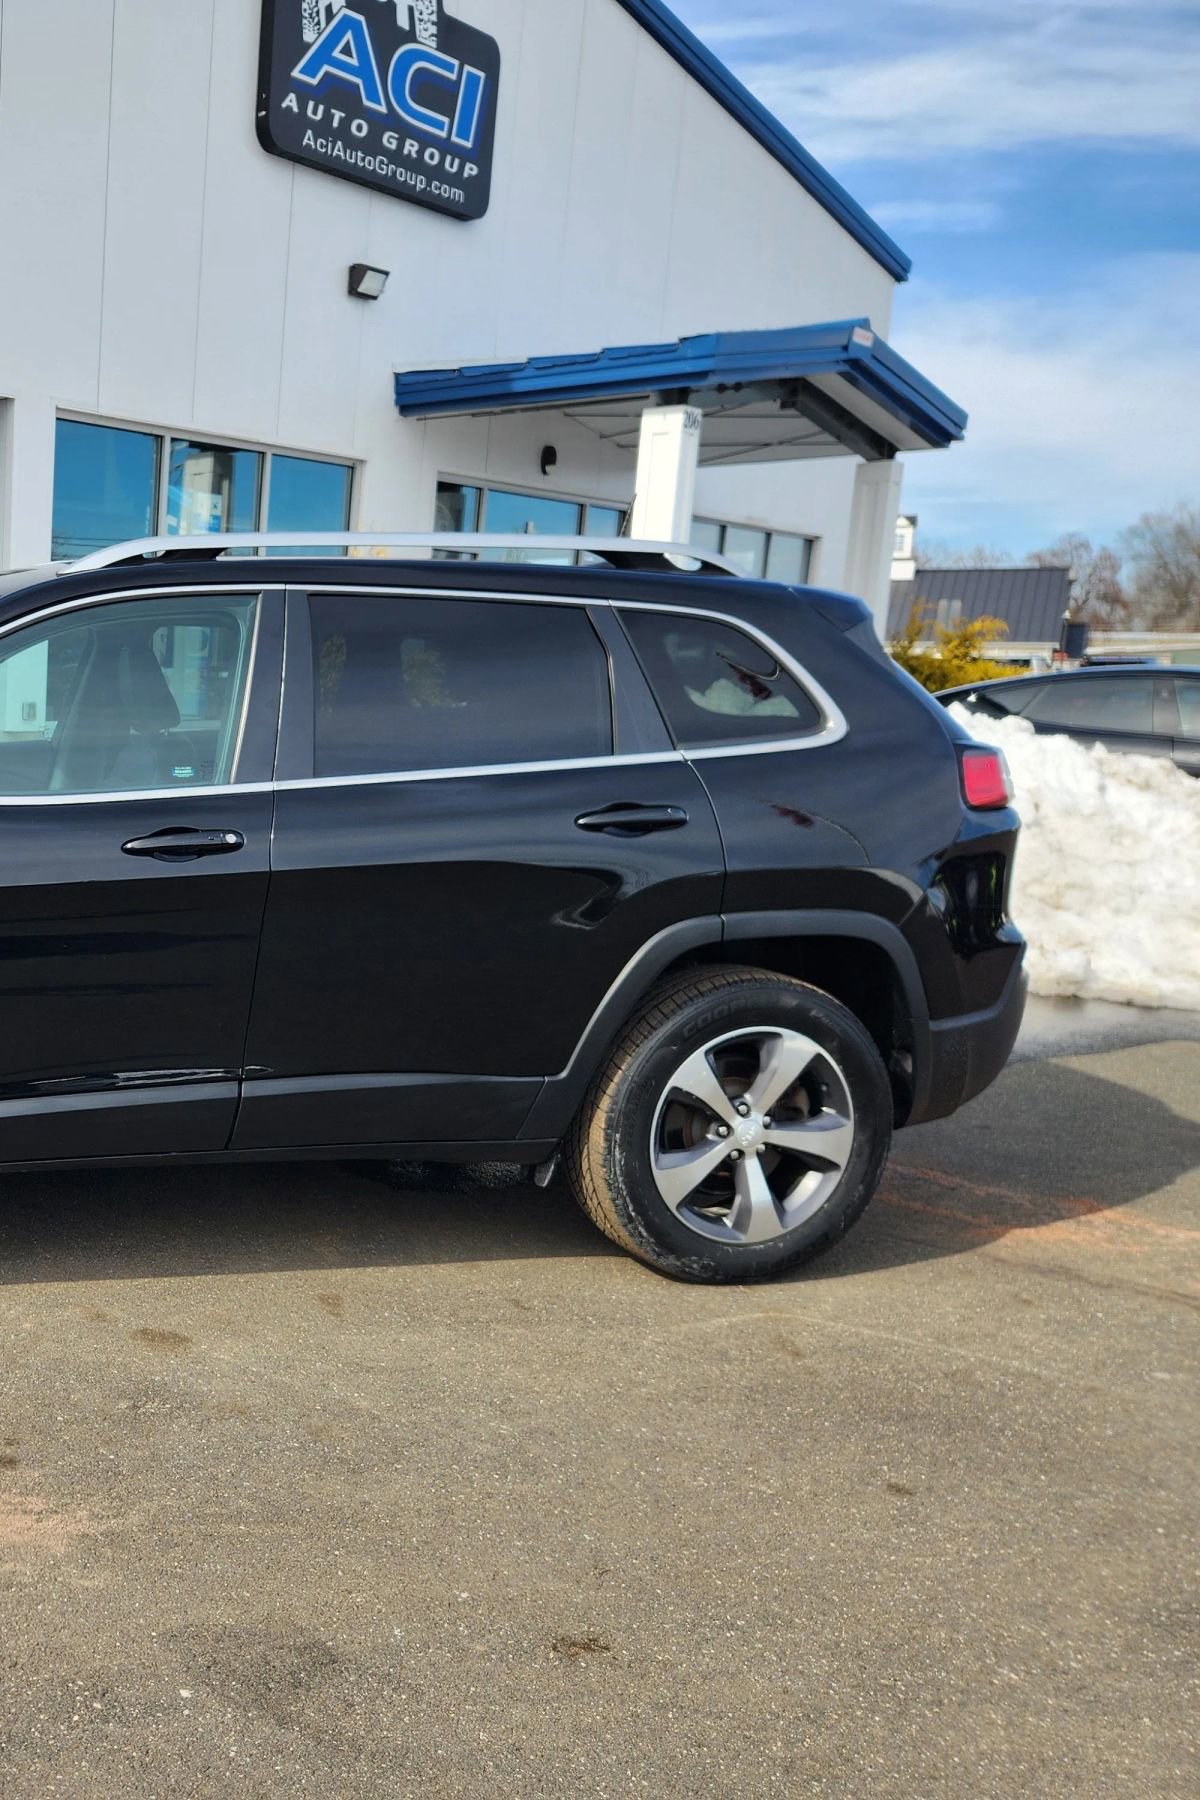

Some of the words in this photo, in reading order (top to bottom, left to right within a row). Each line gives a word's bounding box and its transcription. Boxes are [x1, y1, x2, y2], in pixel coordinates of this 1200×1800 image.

[290, 7, 486, 148] ACI
[281, 92, 369, 138] AUTO
[382, 130, 479, 179] GROUP
[302, 129, 465, 204] AciAutoGroup.com
